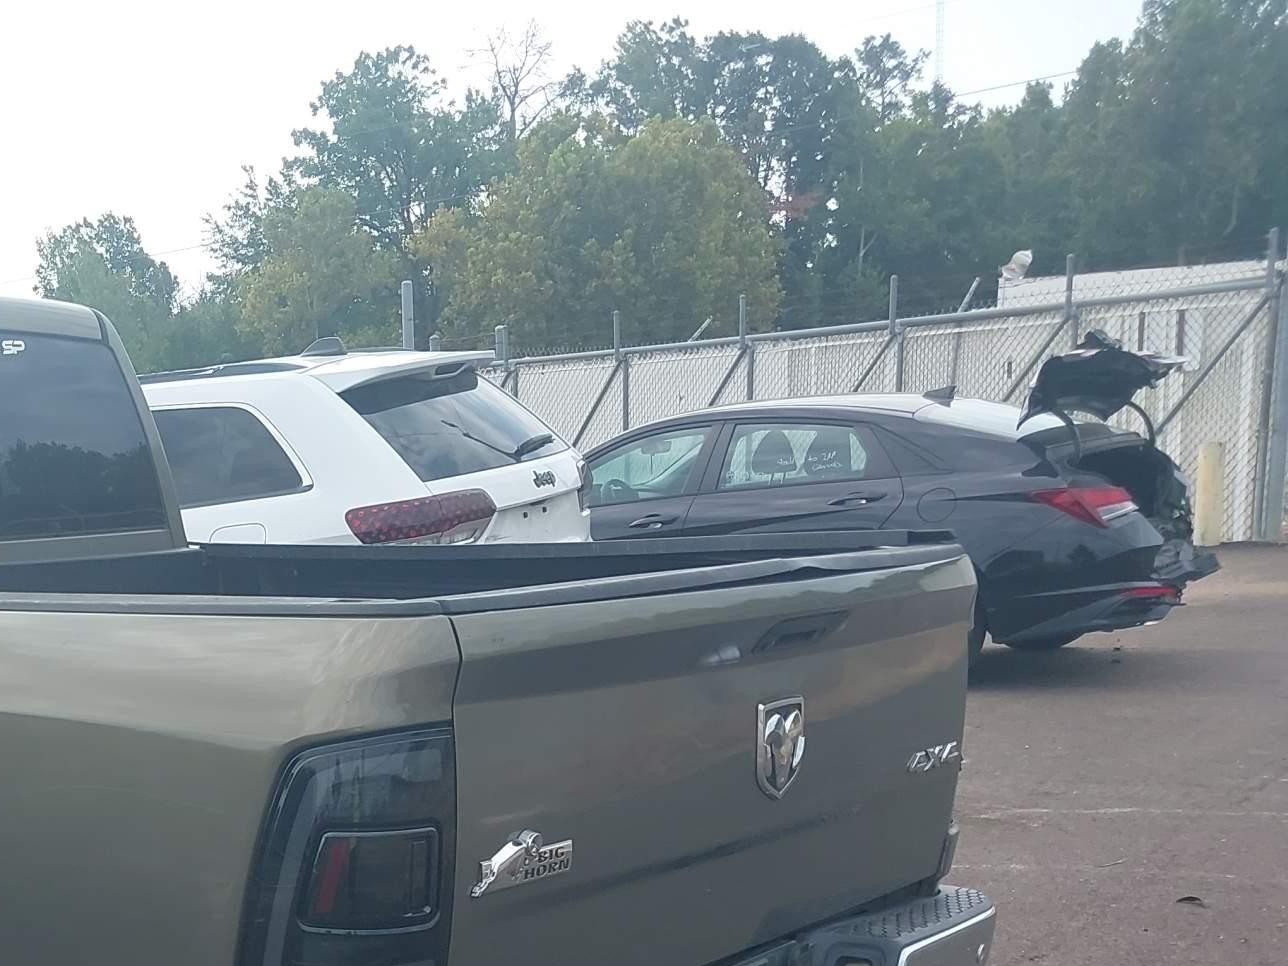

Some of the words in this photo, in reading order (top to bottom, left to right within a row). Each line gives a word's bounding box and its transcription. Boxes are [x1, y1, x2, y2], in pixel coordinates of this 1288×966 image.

[532, 470, 557, 488] Jeep
[536, 846, 566, 864] BIG
[523, 858, 571, 880] HORN
